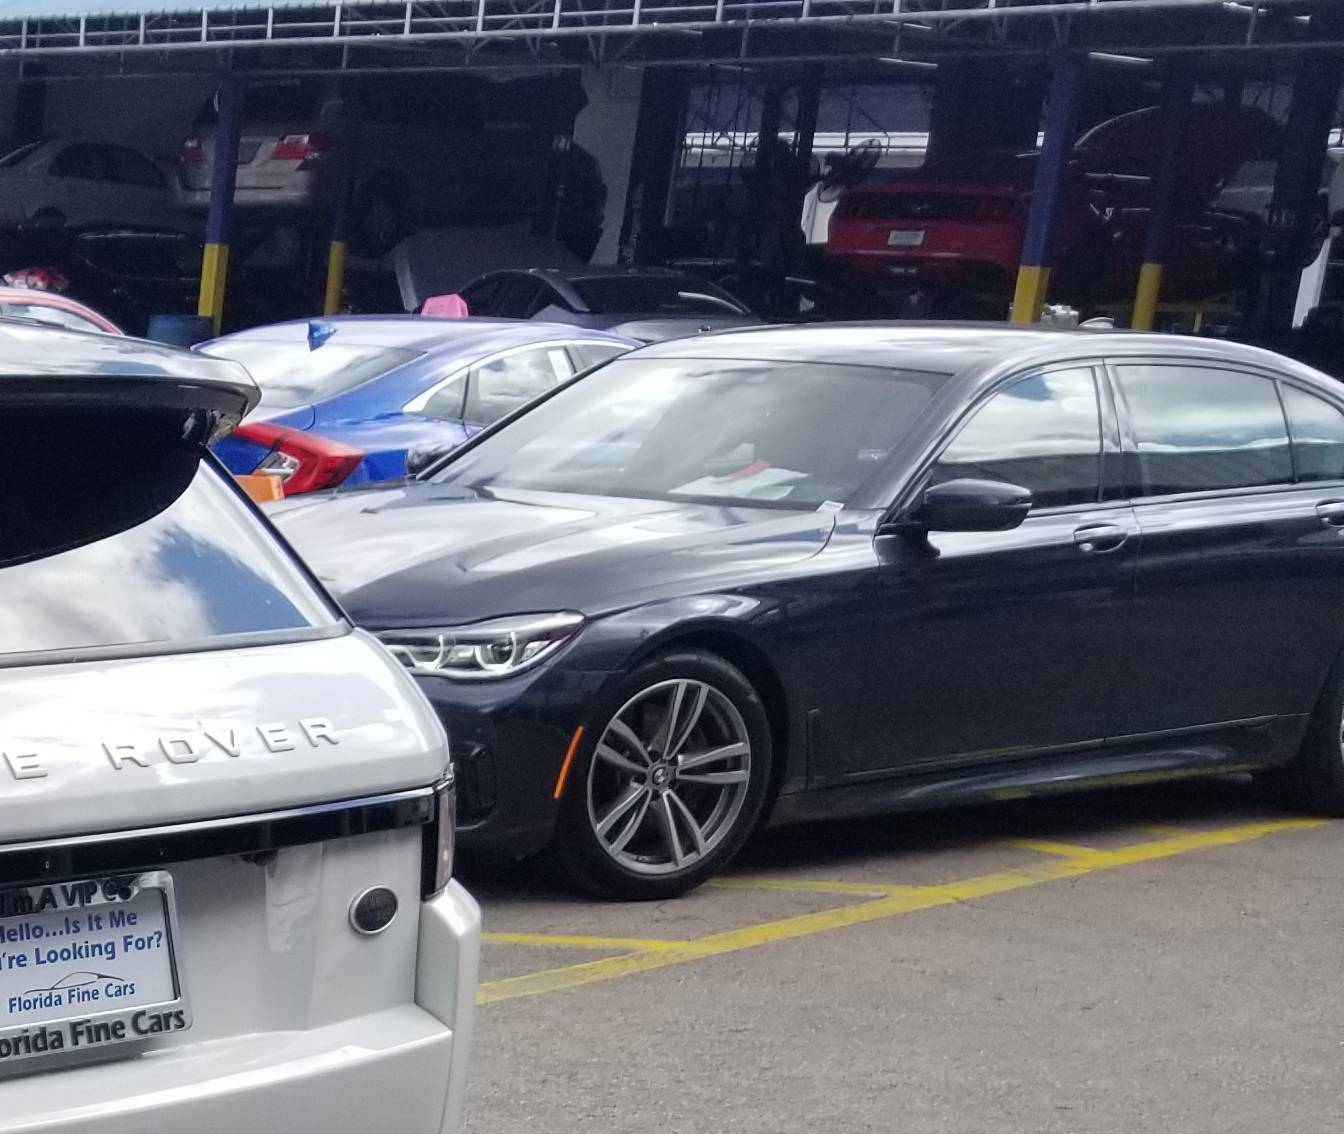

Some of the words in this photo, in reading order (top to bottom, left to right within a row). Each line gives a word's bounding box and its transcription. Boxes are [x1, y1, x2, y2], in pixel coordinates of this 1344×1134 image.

[101, 716, 340, 771] ROVER
[39, 887, 58, 909] A
[61, 880, 98, 907] VIP
[88, 912, 103, 932] It
[109, 909, 138, 929] Me
[34, 940, 116, 966] Looking
[122, 930, 163, 953] For?
[8, 991, 63, 1014] Florida
[67, 987, 100, 1004] Fine
[104, 982, 136, 998] Cars
[68, 1018, 126, 1046] Fine
[130, 1009, 186, 1036] Cars
